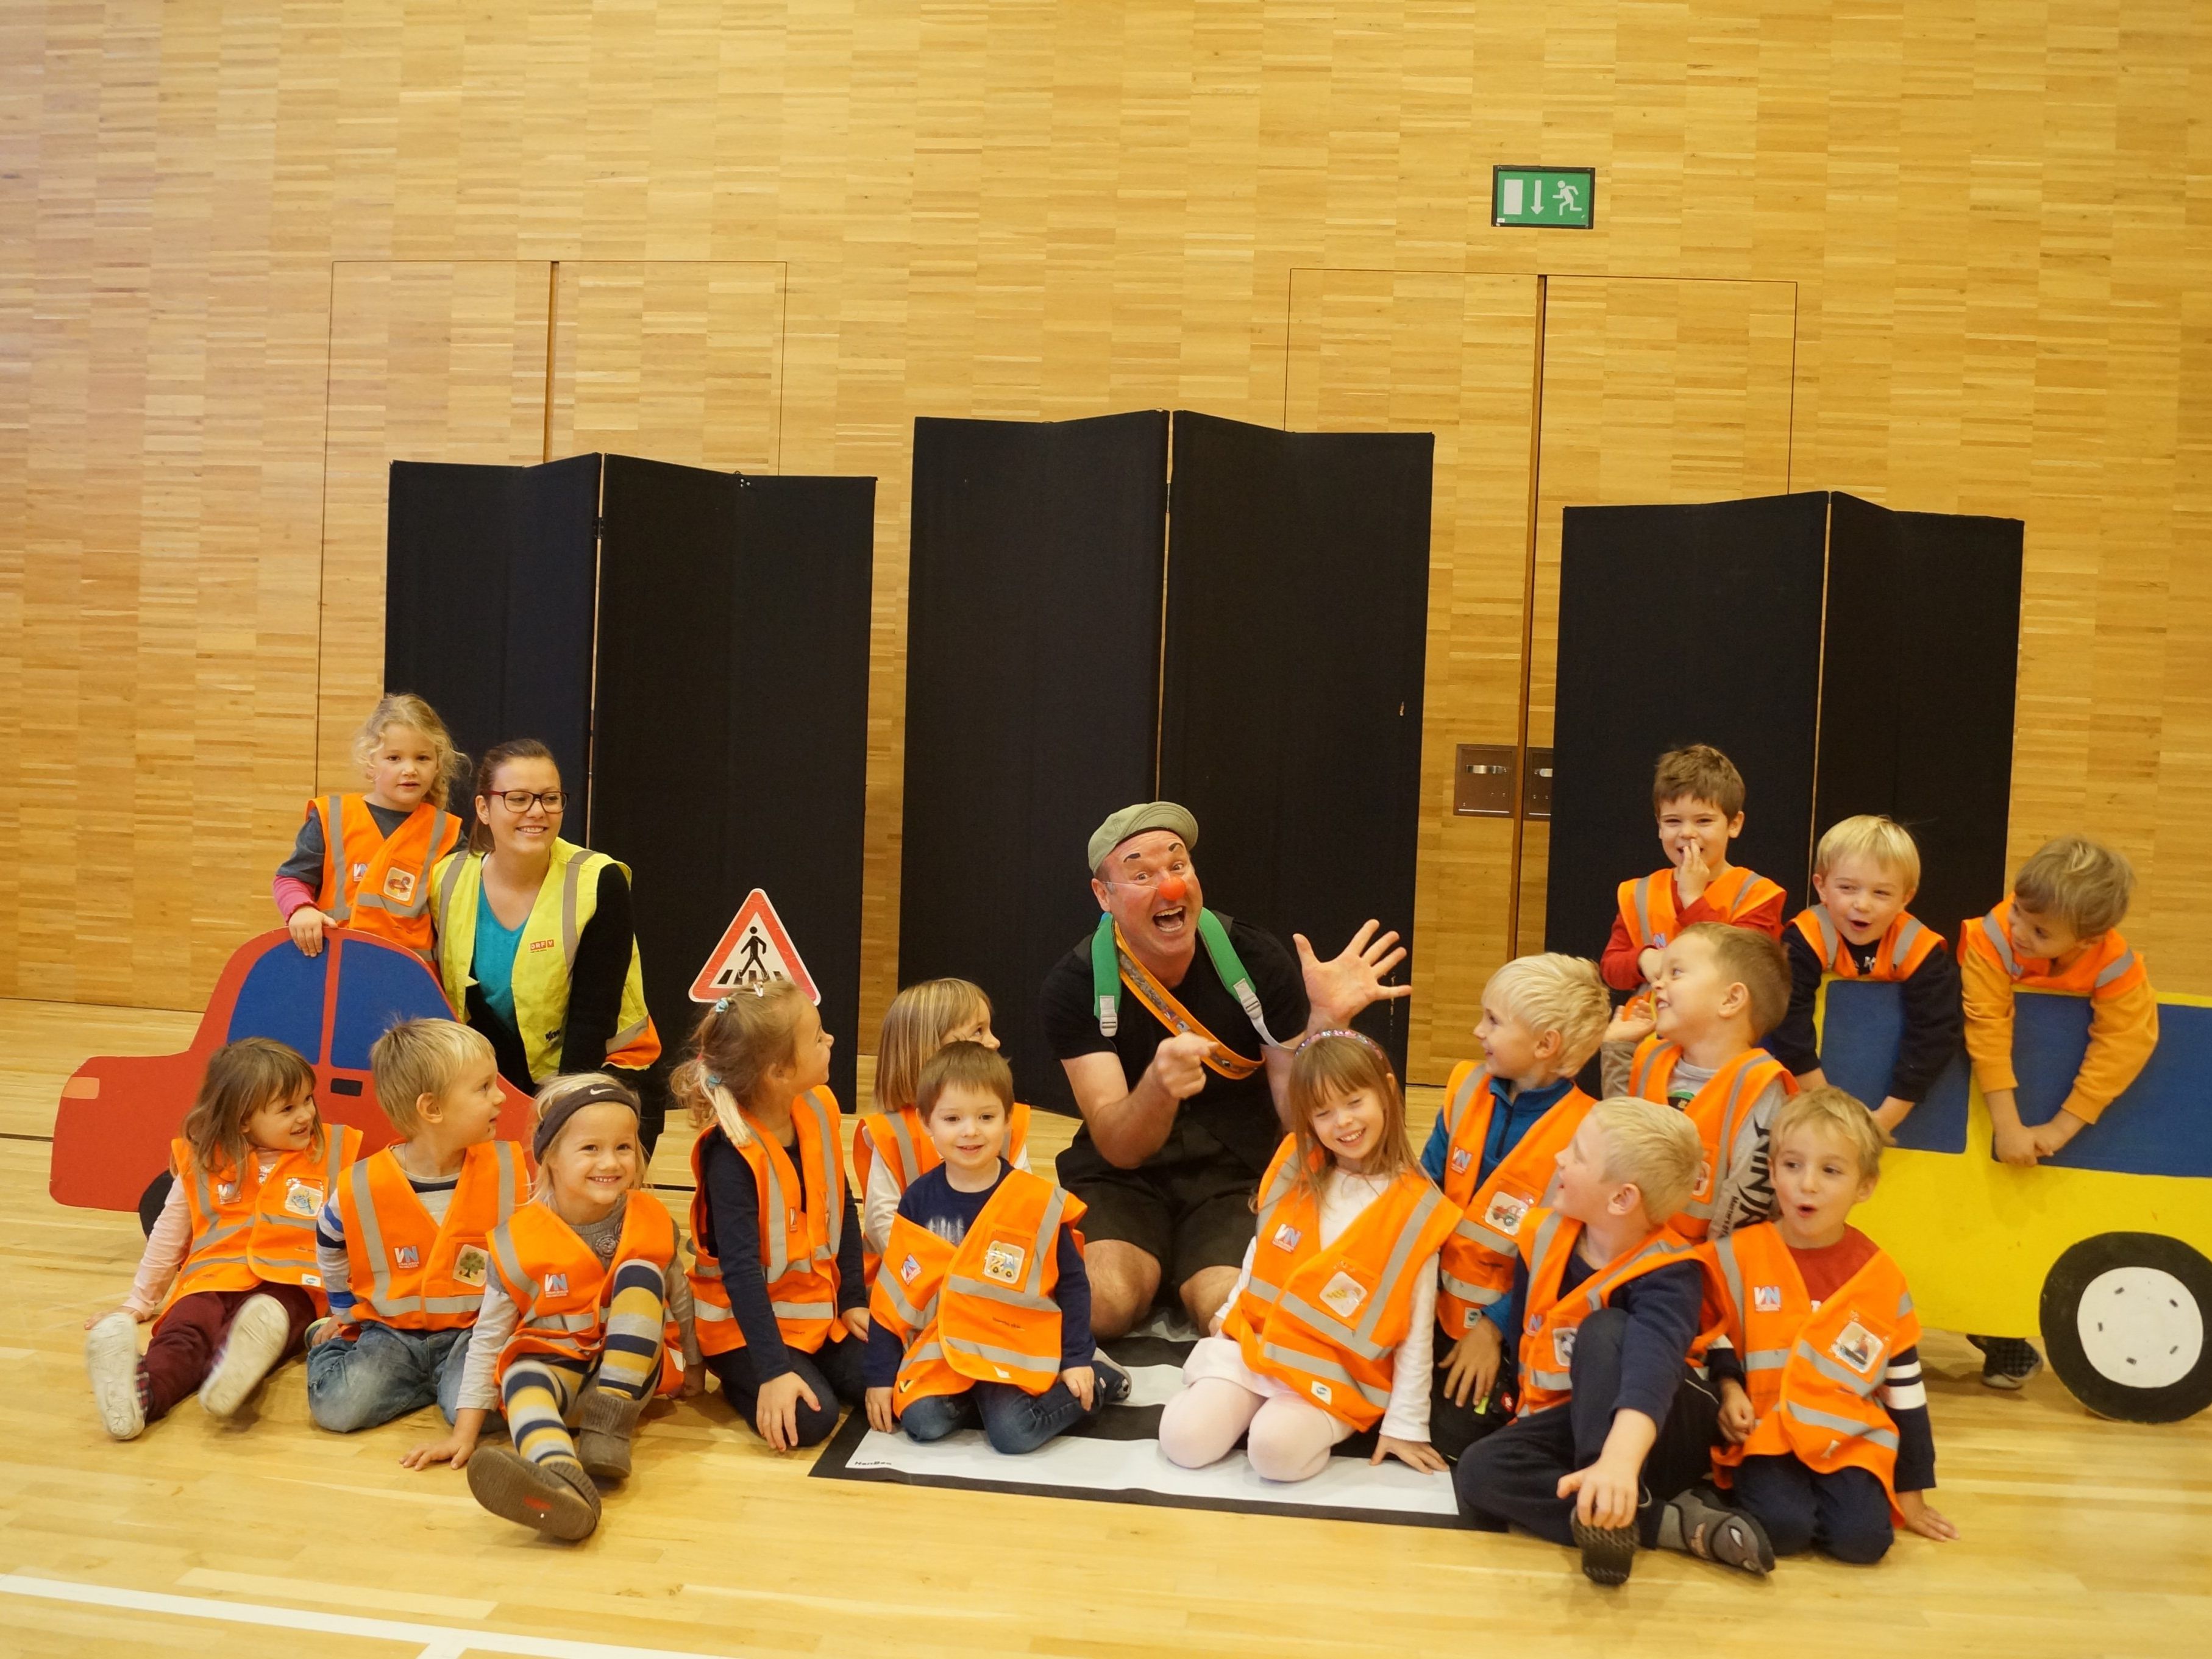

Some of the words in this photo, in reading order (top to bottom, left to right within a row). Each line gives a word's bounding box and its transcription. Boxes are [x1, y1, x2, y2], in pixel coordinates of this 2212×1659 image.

[394, 1246, 419, 1263] VN
[545, 1273, 567, 1291] VN
[1754, 1286, 1780, 1305] VN
